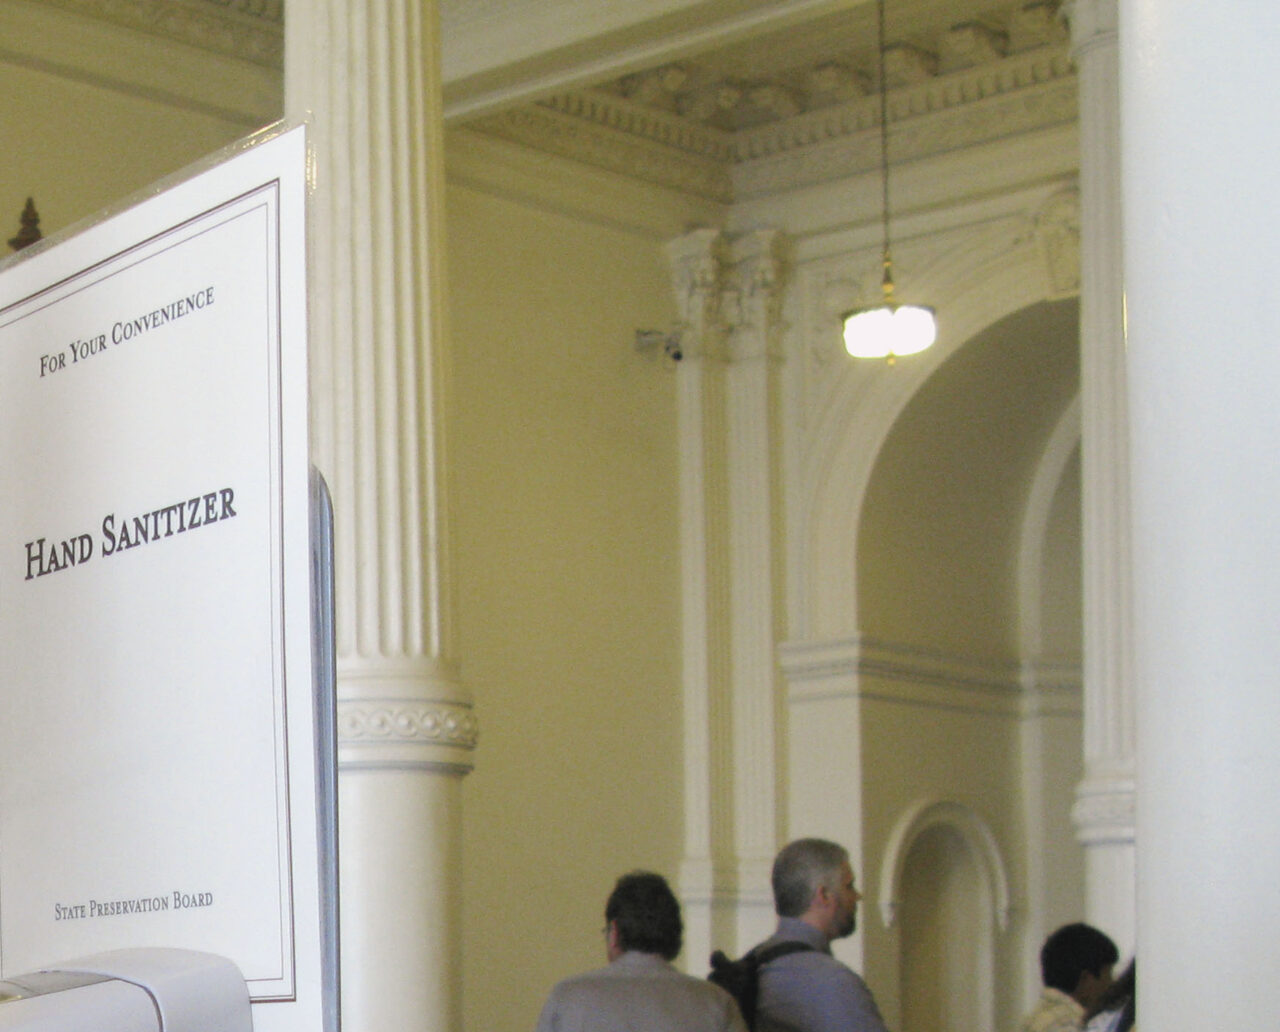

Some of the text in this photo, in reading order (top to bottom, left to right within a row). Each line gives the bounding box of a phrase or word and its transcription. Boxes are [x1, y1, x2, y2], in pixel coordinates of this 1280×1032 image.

[39, 287, 215, 377] FOR YOUR CONVENIENCE
[24, 488, 237, 580] HAND SANITIZER
[55, 891, 213, 921] STATE PRESERVATION BOARD
